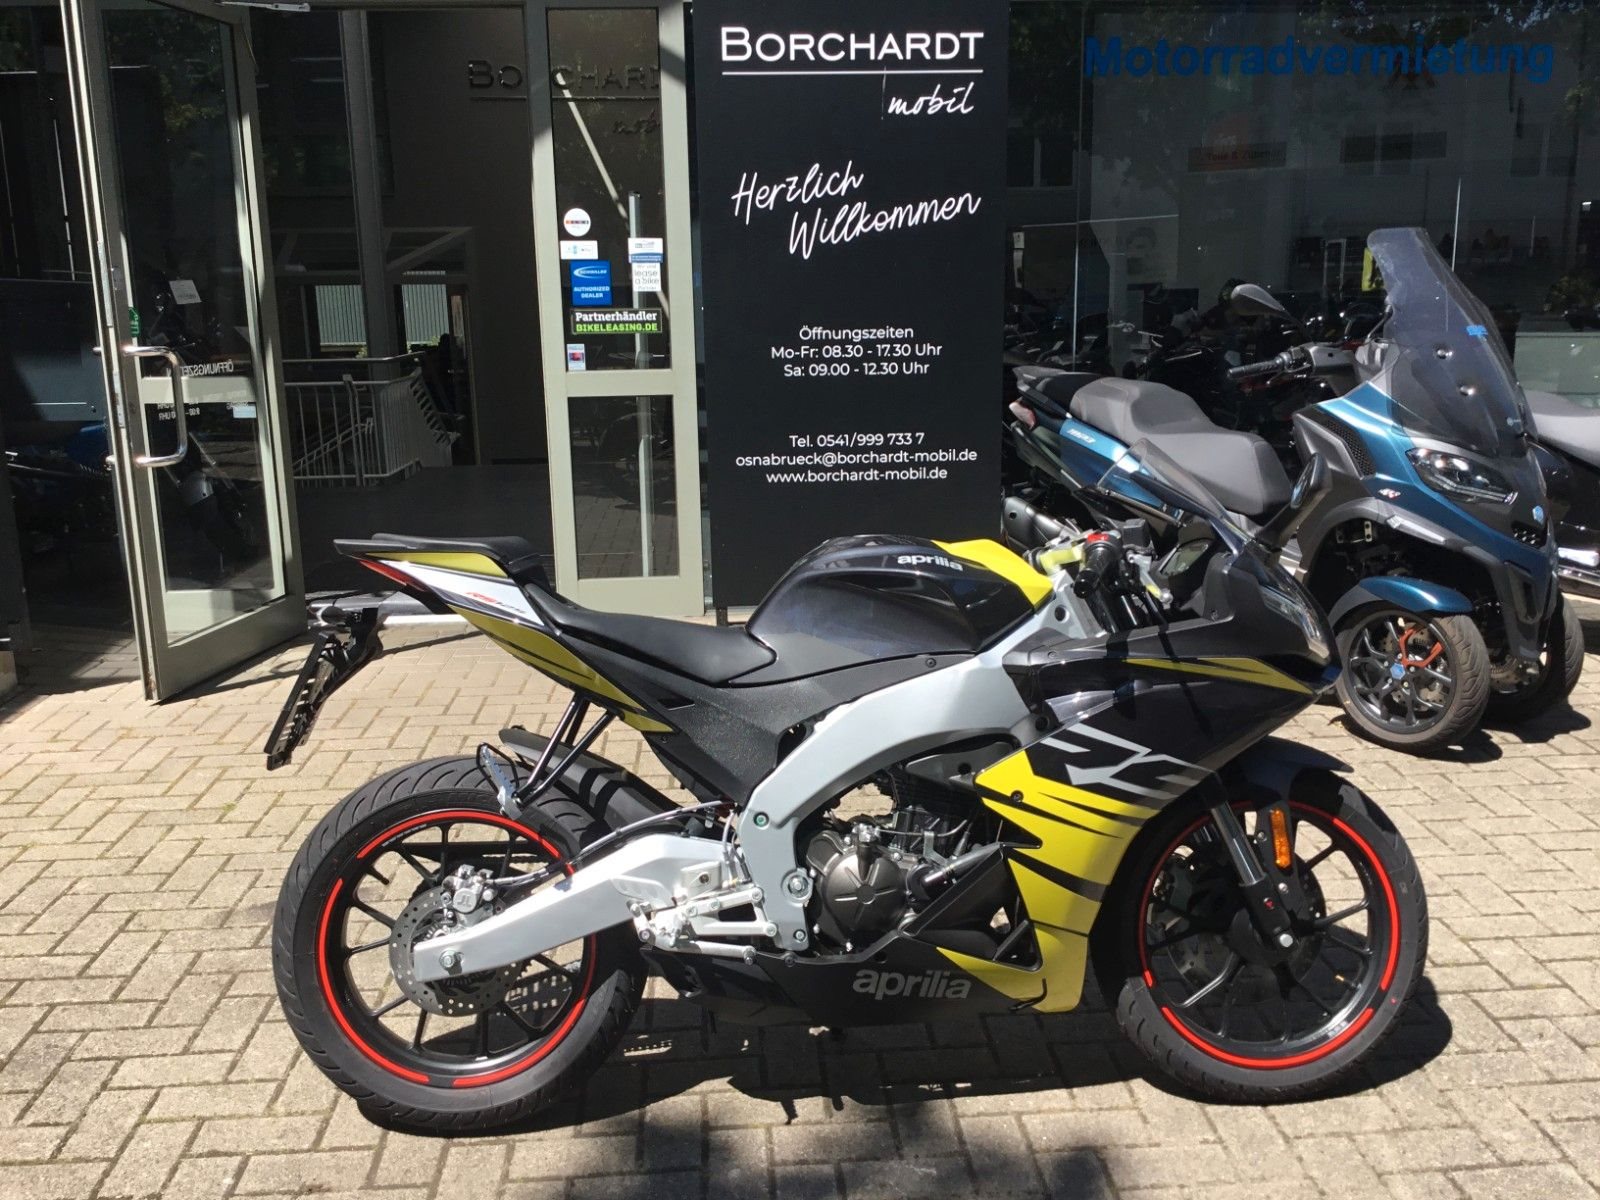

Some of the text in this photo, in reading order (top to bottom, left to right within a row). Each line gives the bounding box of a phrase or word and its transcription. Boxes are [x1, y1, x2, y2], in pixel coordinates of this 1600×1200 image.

[721, 26, 984, 62] BORCHARDT
[1083, 34, 1555, 84] Motorradvermietung
[888, 82, 975, 116] mobil
[731, 160, 864, 226] Herzlich
[789, 192, 982, 260] Willkommen
[575, 311, 658, 322] Partnerhändler
[576, 322, 658, 332] BIKELEASING.DE
[799, 325, 914, 343] Öffnungszeiten
[771, 345, 819, 359] Mo-Fr:
[822, 345, 864, 359] 08.30
[876, 343, 912, 358] 17.30
[916, 343, 943, 357] Uhr
[784, 363, 806, 378] Sa:
[809, 363, 850, 377] 09.00
[863, 362, 899, 376] 12.30
[903, 362, 930, 375] Uhr
[789, 432, 925, 448] Tel. 0541/999 733 7
[735, 449, 978, 467] osnabrueck@borchardt-mobil.de
[766, 467, 948, 483] www.borchardt-mobil.de
[897, 554, 963, 572] aprilia
[853, 969, 971, 1001] aprilia
